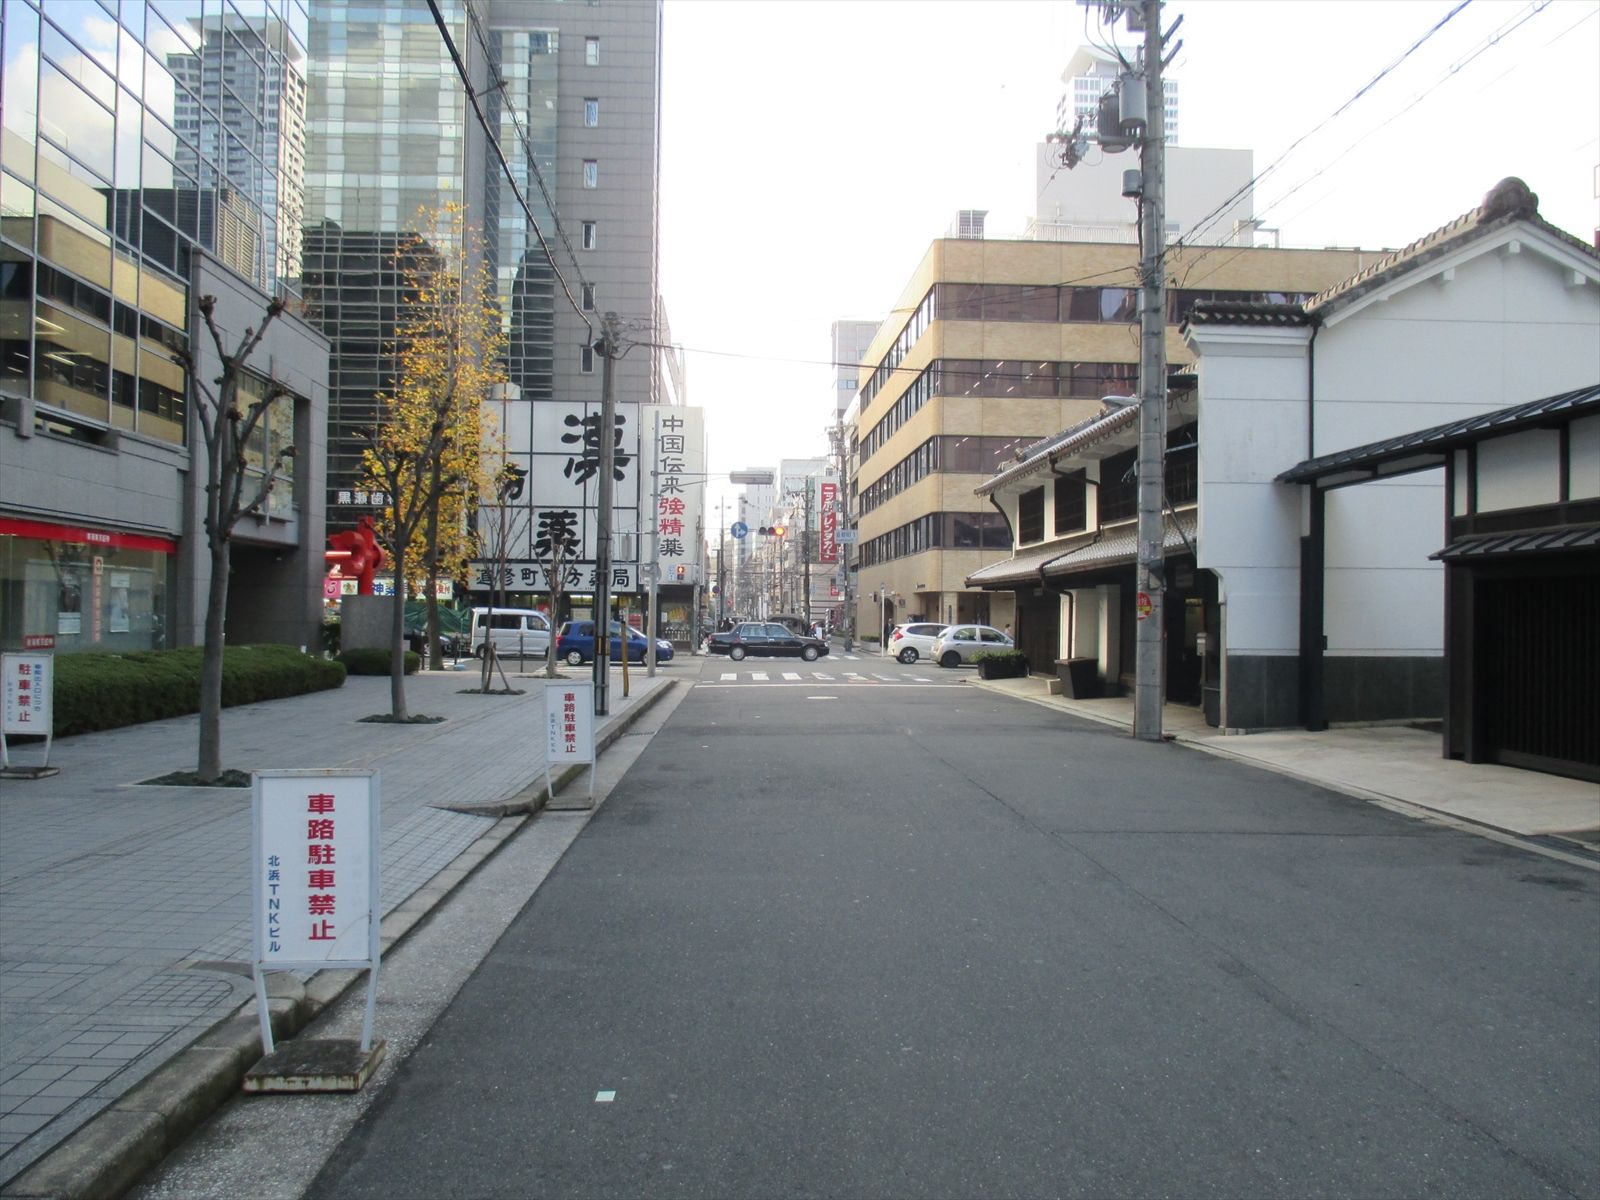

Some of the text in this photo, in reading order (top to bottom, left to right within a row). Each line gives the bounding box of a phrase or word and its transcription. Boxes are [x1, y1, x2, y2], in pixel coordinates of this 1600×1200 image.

[659, 414, 686, 558] 中国伝来強精薬
[17, 663, 32, 723] 駐車禁止
[563, 693, 577, 753] 車路駐車禁止
[267, 854, 281, 954] 北浜TNKビル
[307, 793, 337, 942] 車路駐車禁止
